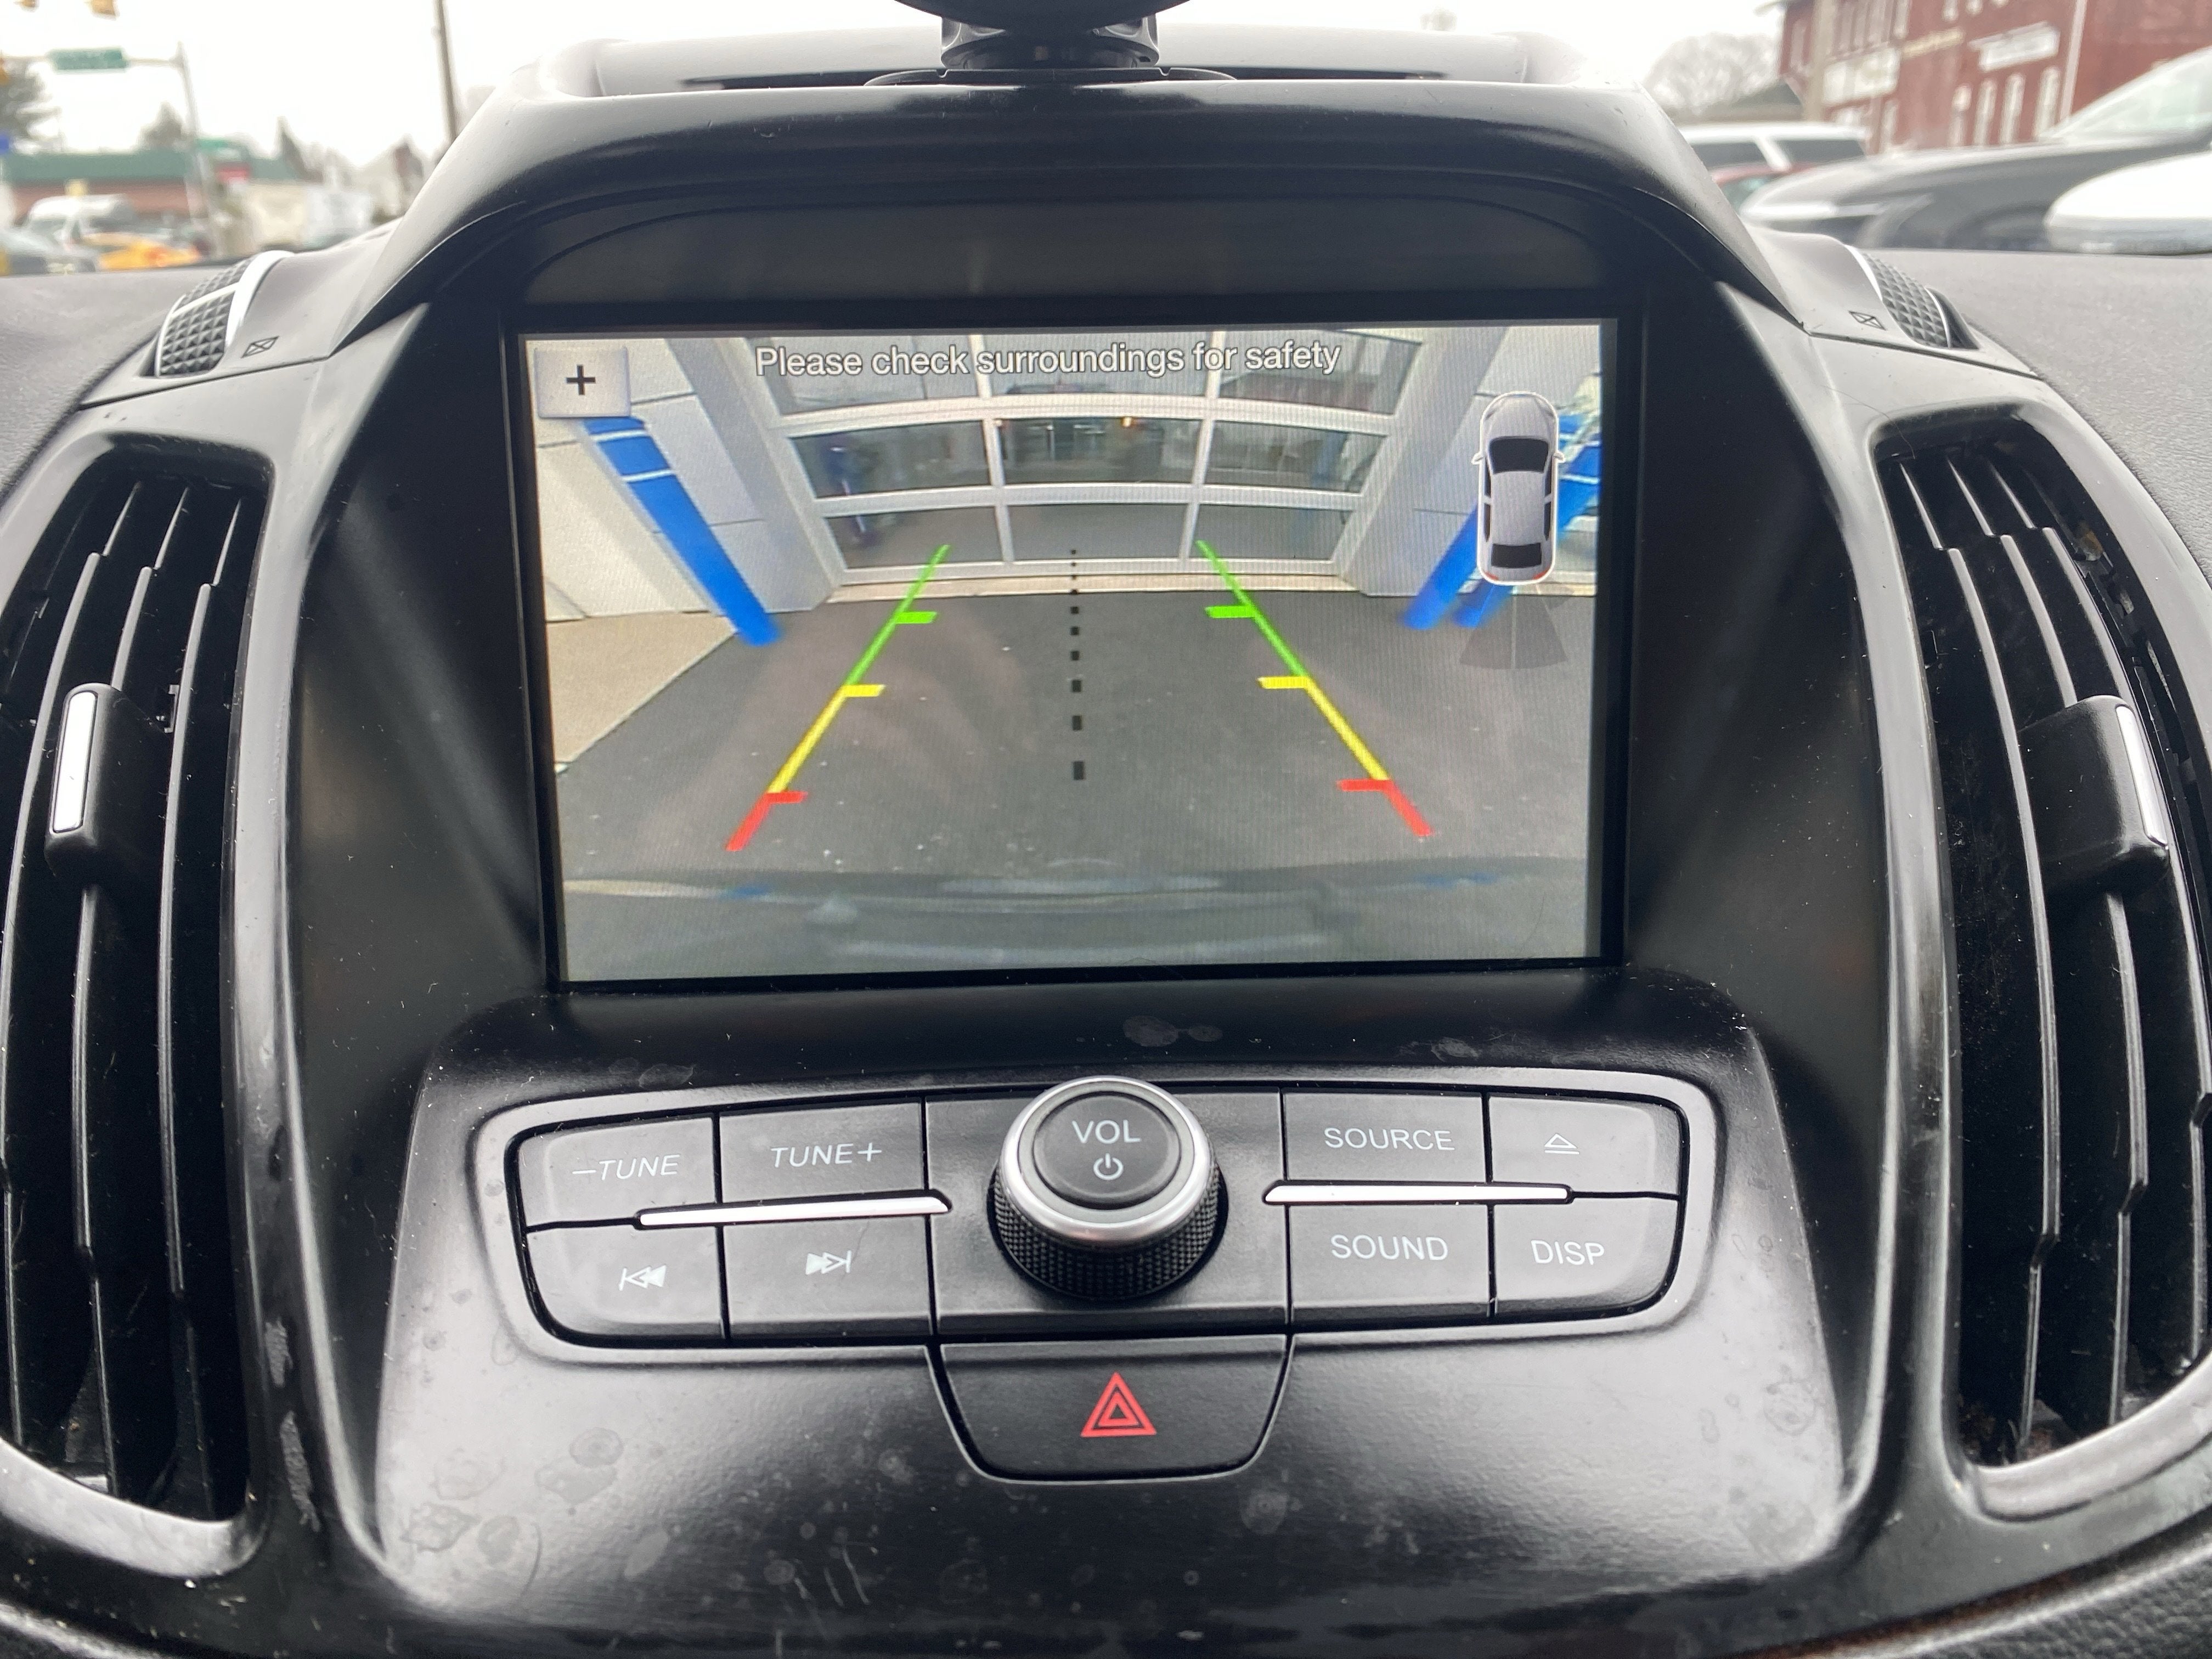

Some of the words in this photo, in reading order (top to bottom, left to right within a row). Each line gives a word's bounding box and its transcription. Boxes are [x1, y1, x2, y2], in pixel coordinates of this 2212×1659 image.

[755, 346, 862, 376] Please
[872, 345, 969, 374] check
[976, 343, 1184, 377] surroundings
[1194, 340, 1237, 371] for
[1245, 338, 1341, 374] safety
[1072, 1119, 1141, 1144] VOL
[1324, 1127, 1455, 1151] SOURCE
[771, 1142, 882, 1167] TUNE+
[1331, 1234, 1449, 1261] SOUND
[1531, 1239, 1605, 1265] DISP
